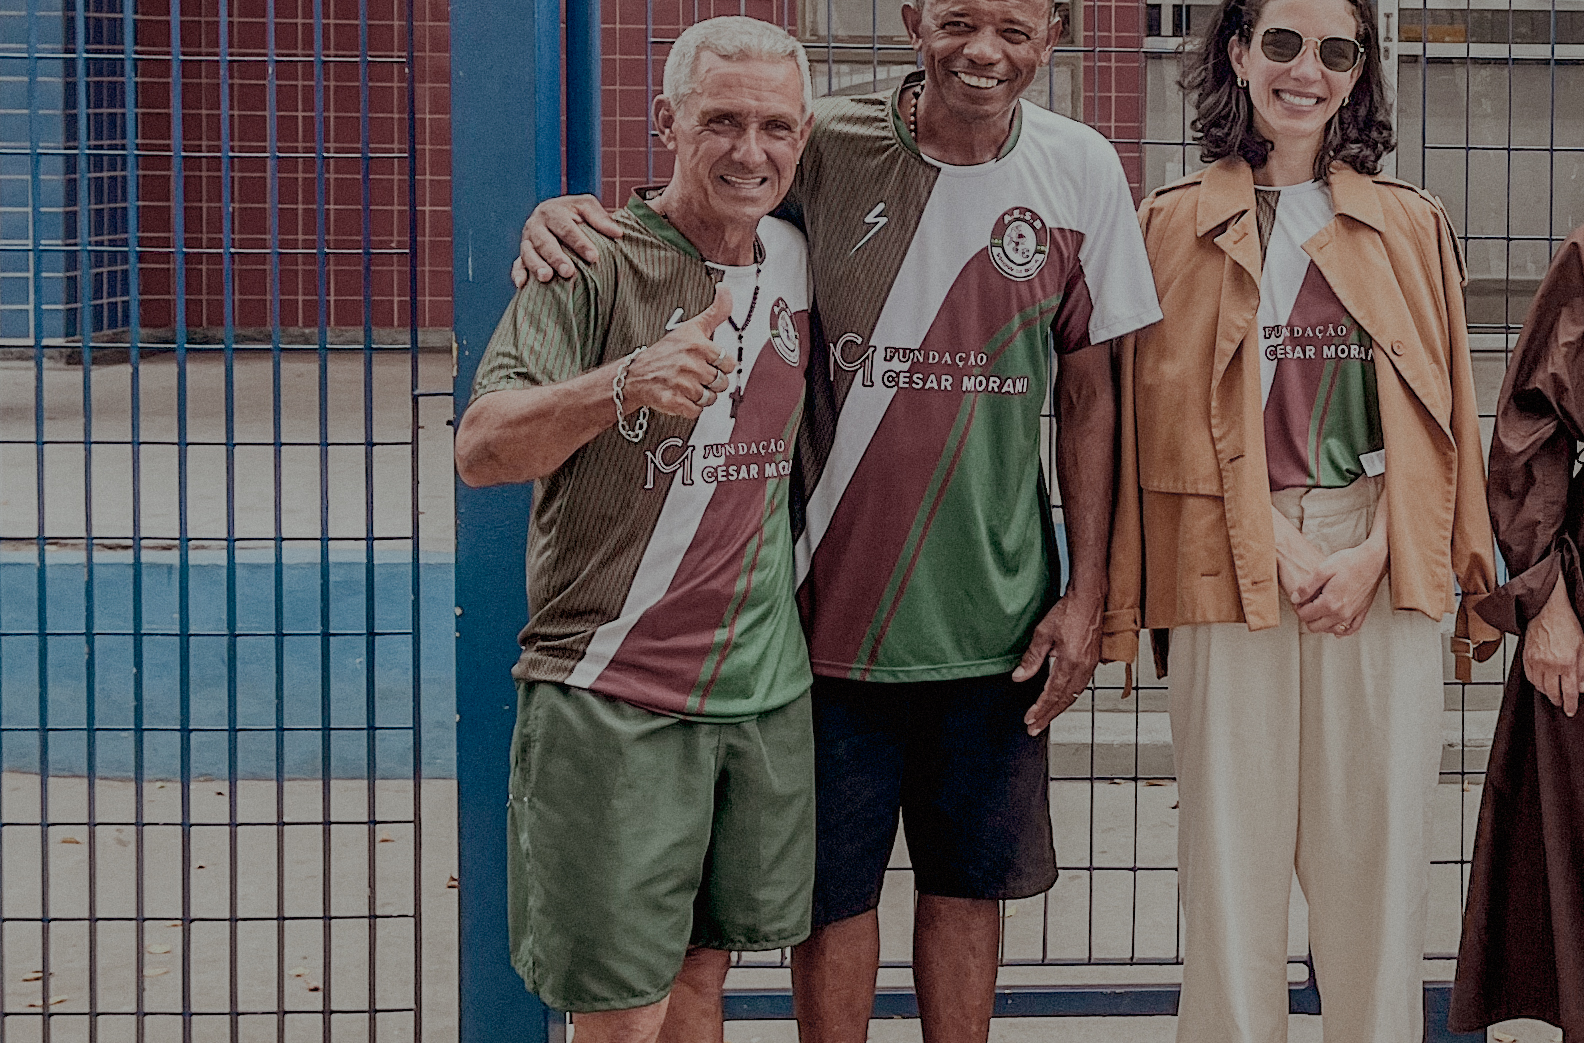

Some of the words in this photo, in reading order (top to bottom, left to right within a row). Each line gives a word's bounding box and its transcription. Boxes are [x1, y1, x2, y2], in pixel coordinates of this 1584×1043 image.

[1263, 323, 1347, 339] FUNDAÇÃO
[884, 347, 988, 368] FUNDAÇÃO
[1265, 345, 1316, 360] CESAR
[882, 369, 953, 391] CESAR
[962, 375, 1029, 394] MORANI
[703, 439, 785, 459] FUNDAÇÃO
[702, 464, 759, 483] CESAR
